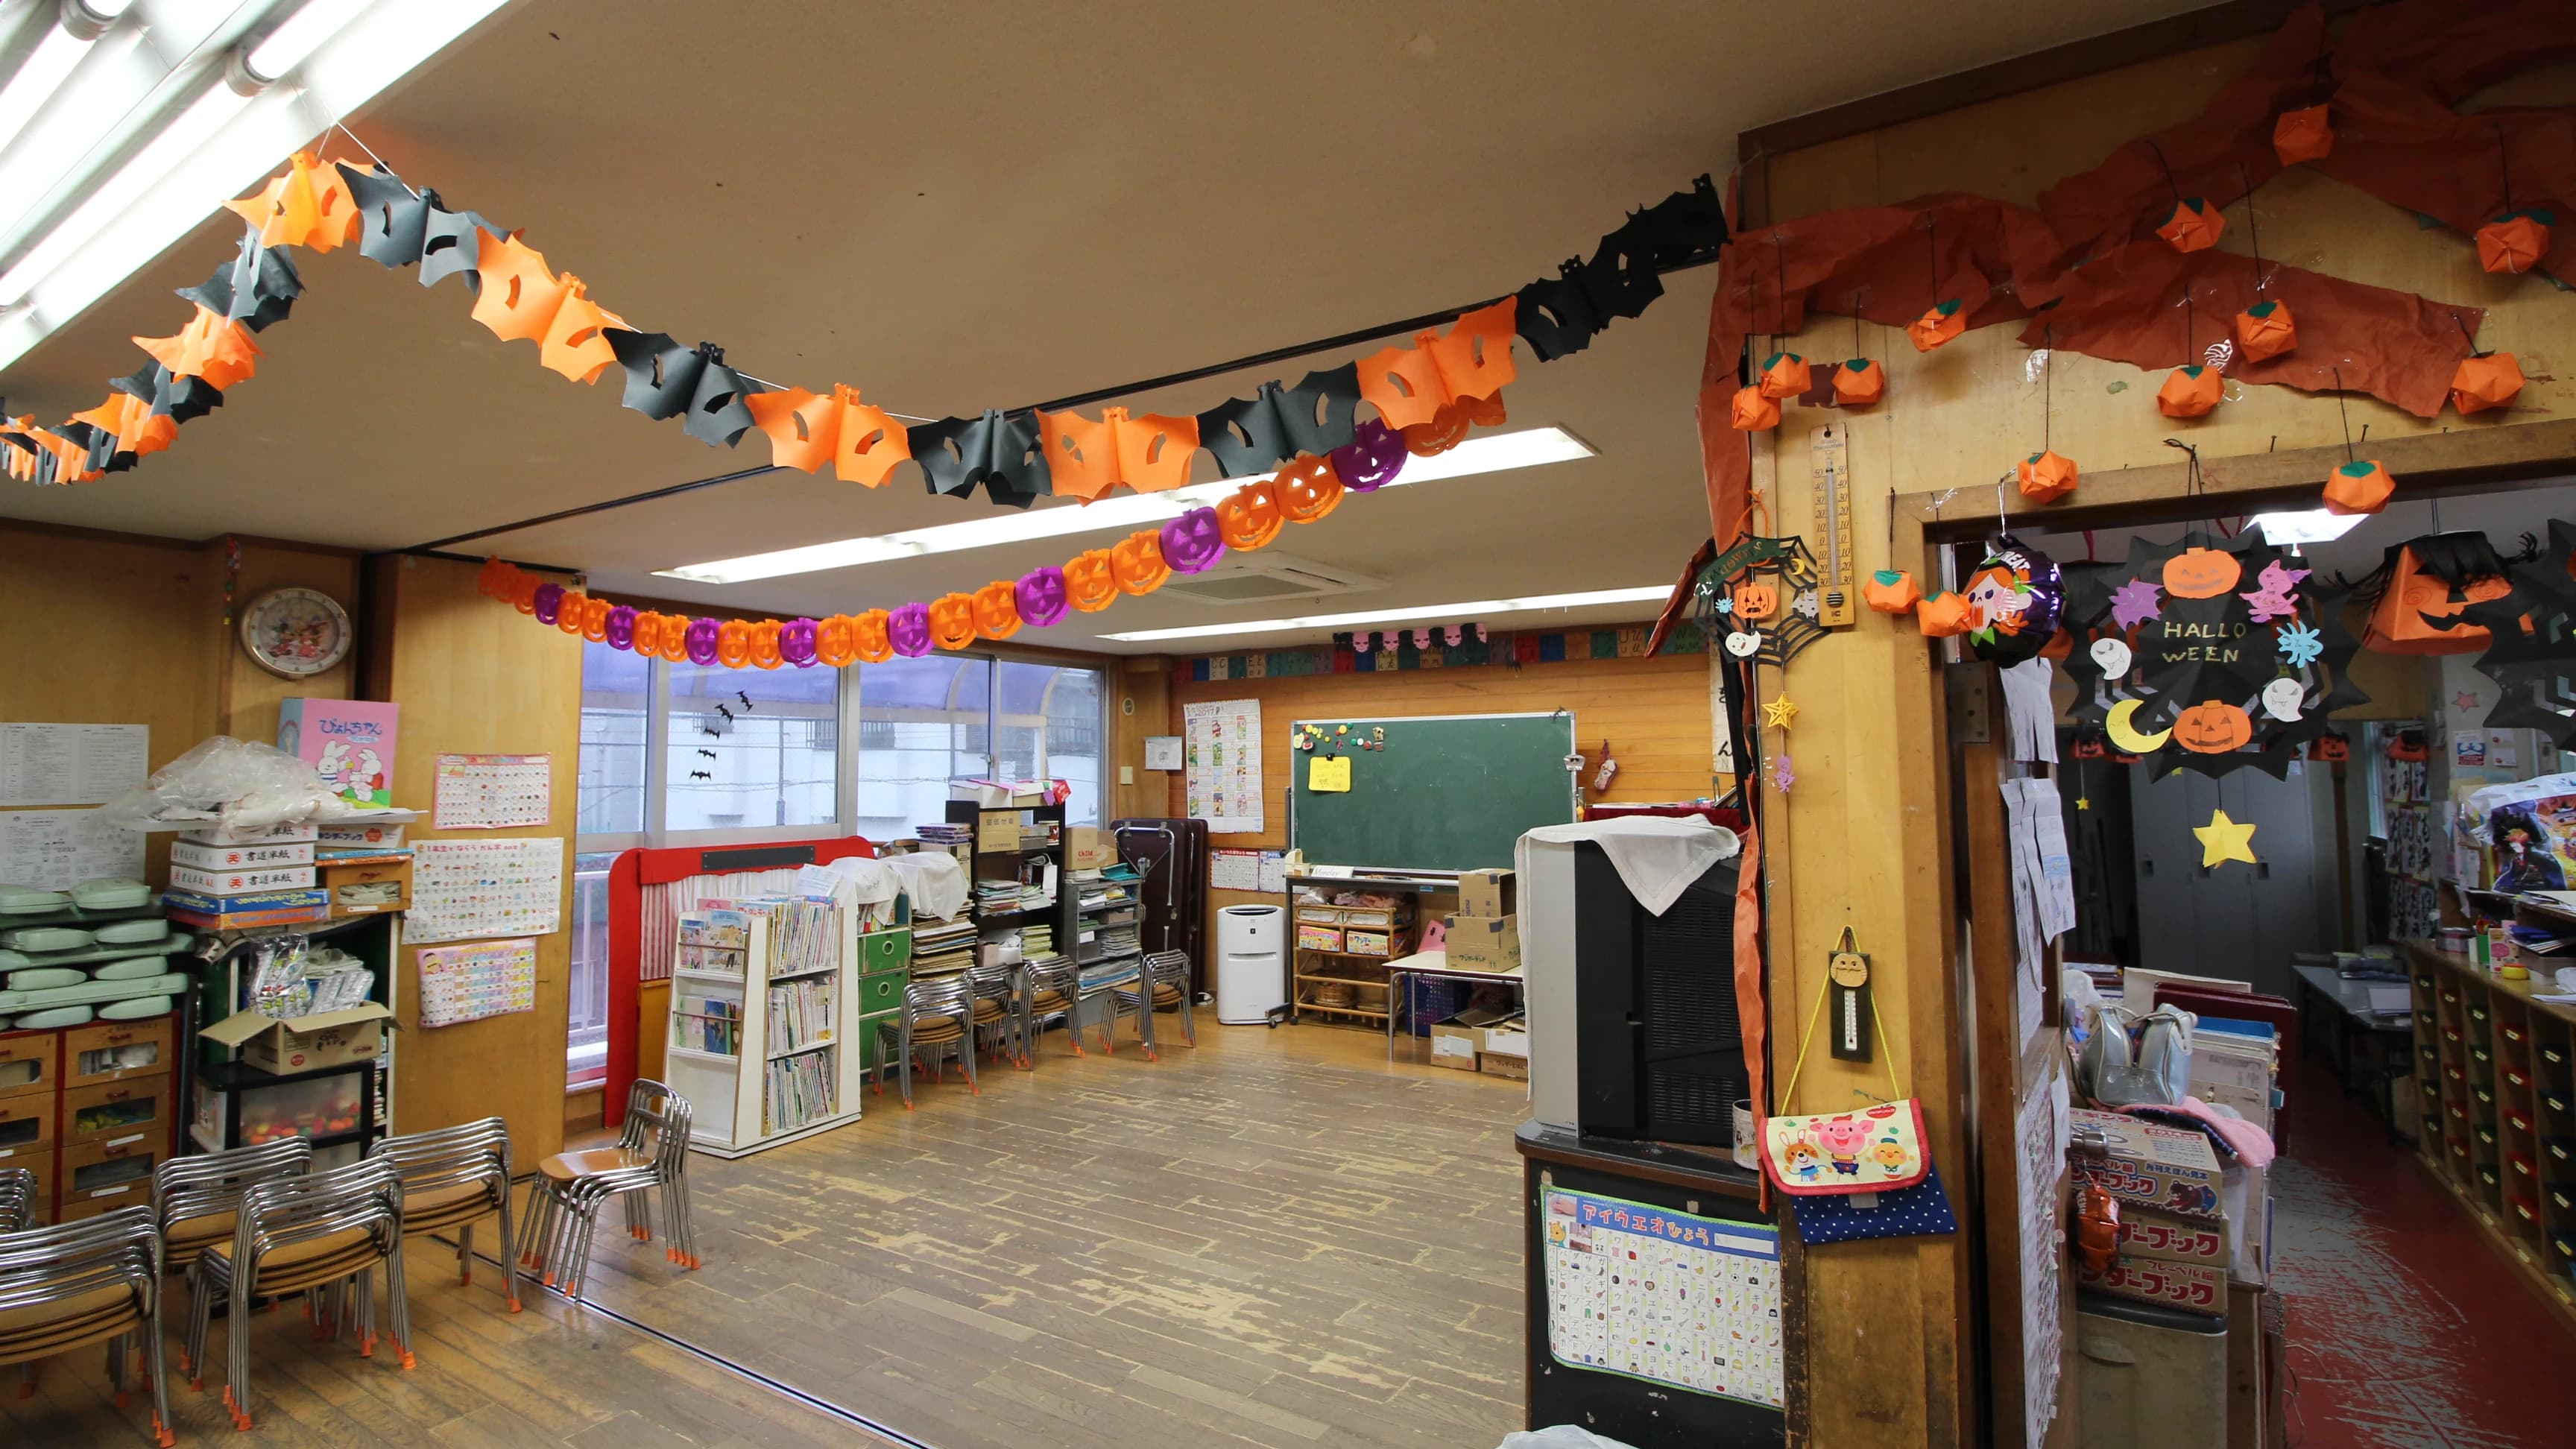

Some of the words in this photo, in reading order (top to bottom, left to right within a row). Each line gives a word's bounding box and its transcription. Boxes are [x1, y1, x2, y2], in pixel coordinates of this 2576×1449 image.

[1837, 465, 1846, 473] 50
[1839, 493, 1848, 502] 30
[1842, 562, 1851, 570] 20
[2164, 622, 2247, 639] HALLO
[2162, 646, 2240, 663] WEEN
[318, 718, 382, 735] ぴょんちゃん
[244, 850, 290, 862] 書道半紙
[248, 874, 292, 886] 書道半紙
[1582, 1204, 1709, 1246] アイウエオひょう
